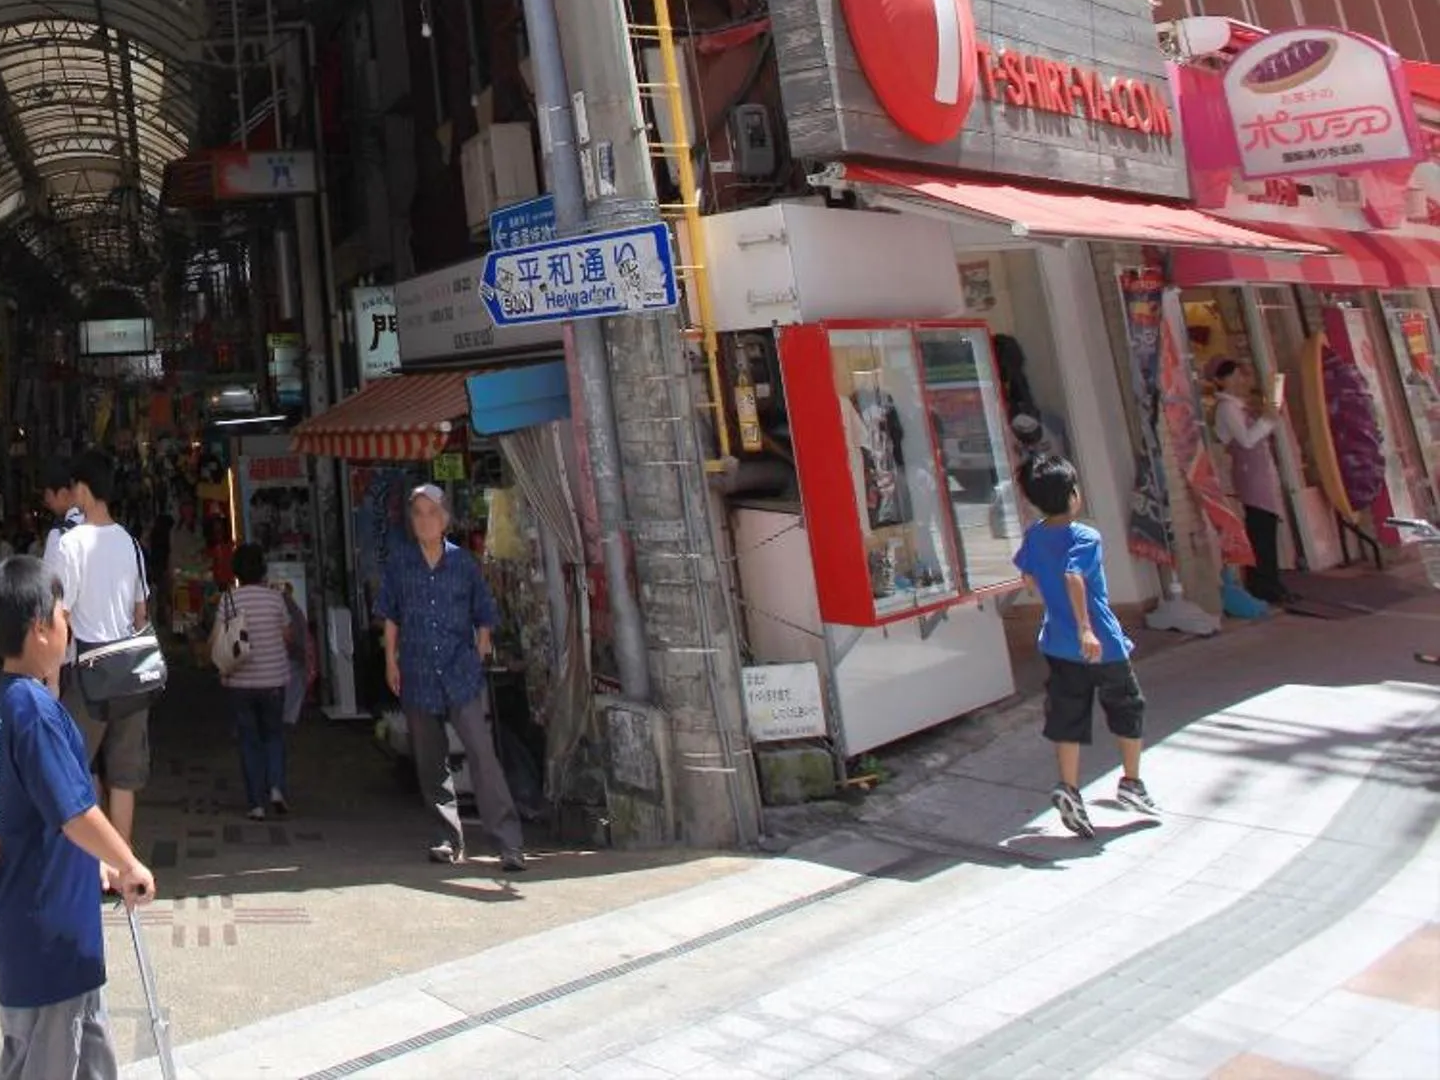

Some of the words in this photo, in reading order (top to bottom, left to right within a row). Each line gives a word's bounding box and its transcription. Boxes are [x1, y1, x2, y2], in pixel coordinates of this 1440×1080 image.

[976, 43, 1172, 136] T-SHIRT-YA.COM
[1240, 105, 1392, 152] ポルシェ
[517, 241, 637, 288] 平和通り
